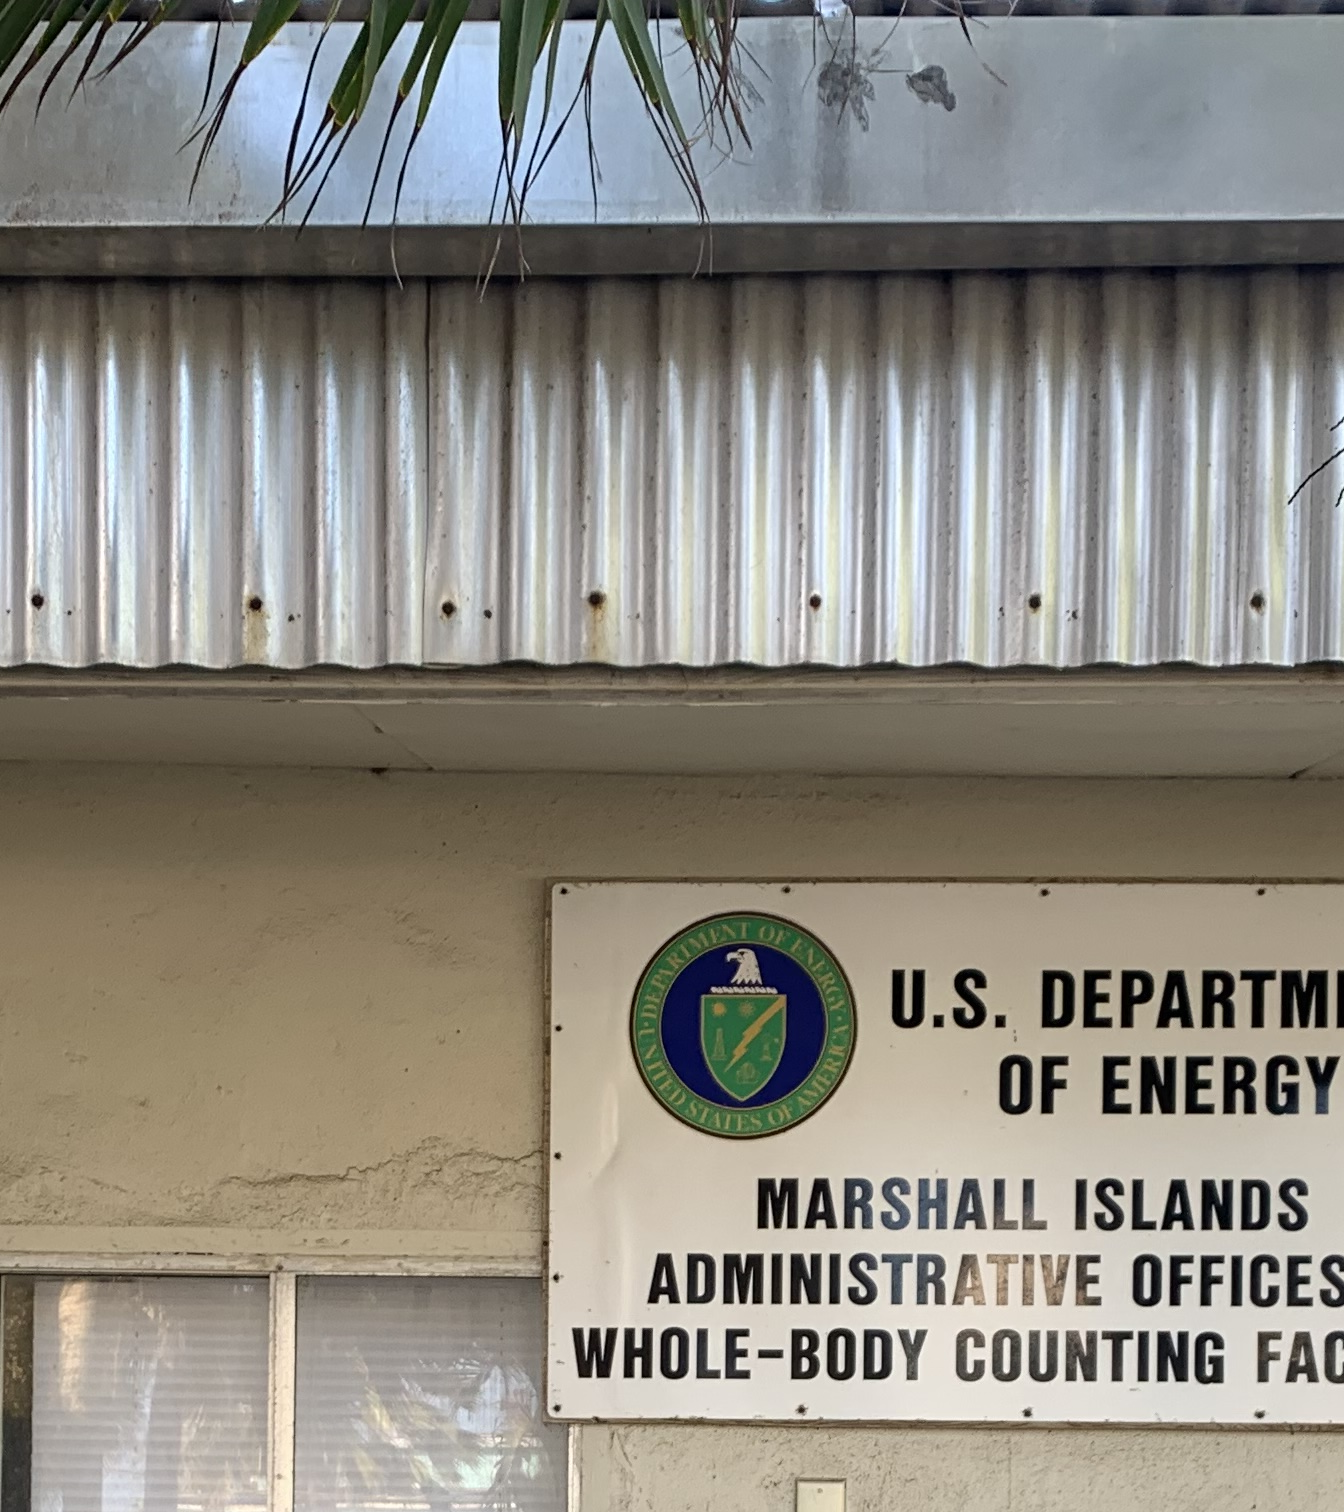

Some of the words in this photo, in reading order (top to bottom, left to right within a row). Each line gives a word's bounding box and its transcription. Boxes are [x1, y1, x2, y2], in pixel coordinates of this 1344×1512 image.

[640, 921, 751, 1020] DEPARTMENT
[759, 924, 792, 947] OF
[793, 937, 848, 1014] ENERGY
[892, 969, 1006, 1028] U.S.
[639, 1026, 687, 1111] UNITED
[687, 1100, 763, 1132] STATES
[767, 1104, 794, 1127] OF
[797, 1023, 849, 1117] AMERICA
[999, 1055, 1067, 1115] OF
[1102, 1055, 1340, 1115] ENERGY
[757, 1177, 1047, 1231] MARSHALL
[1076, 1178, 1309, 1231] ISLANDS
[648, 1253, 1102, 1306] ADMINISTRATIVE
[572, 1327, 926, 1381] WHOLE-BODY
[955, 1330, 1225, 1384] COUNTING
